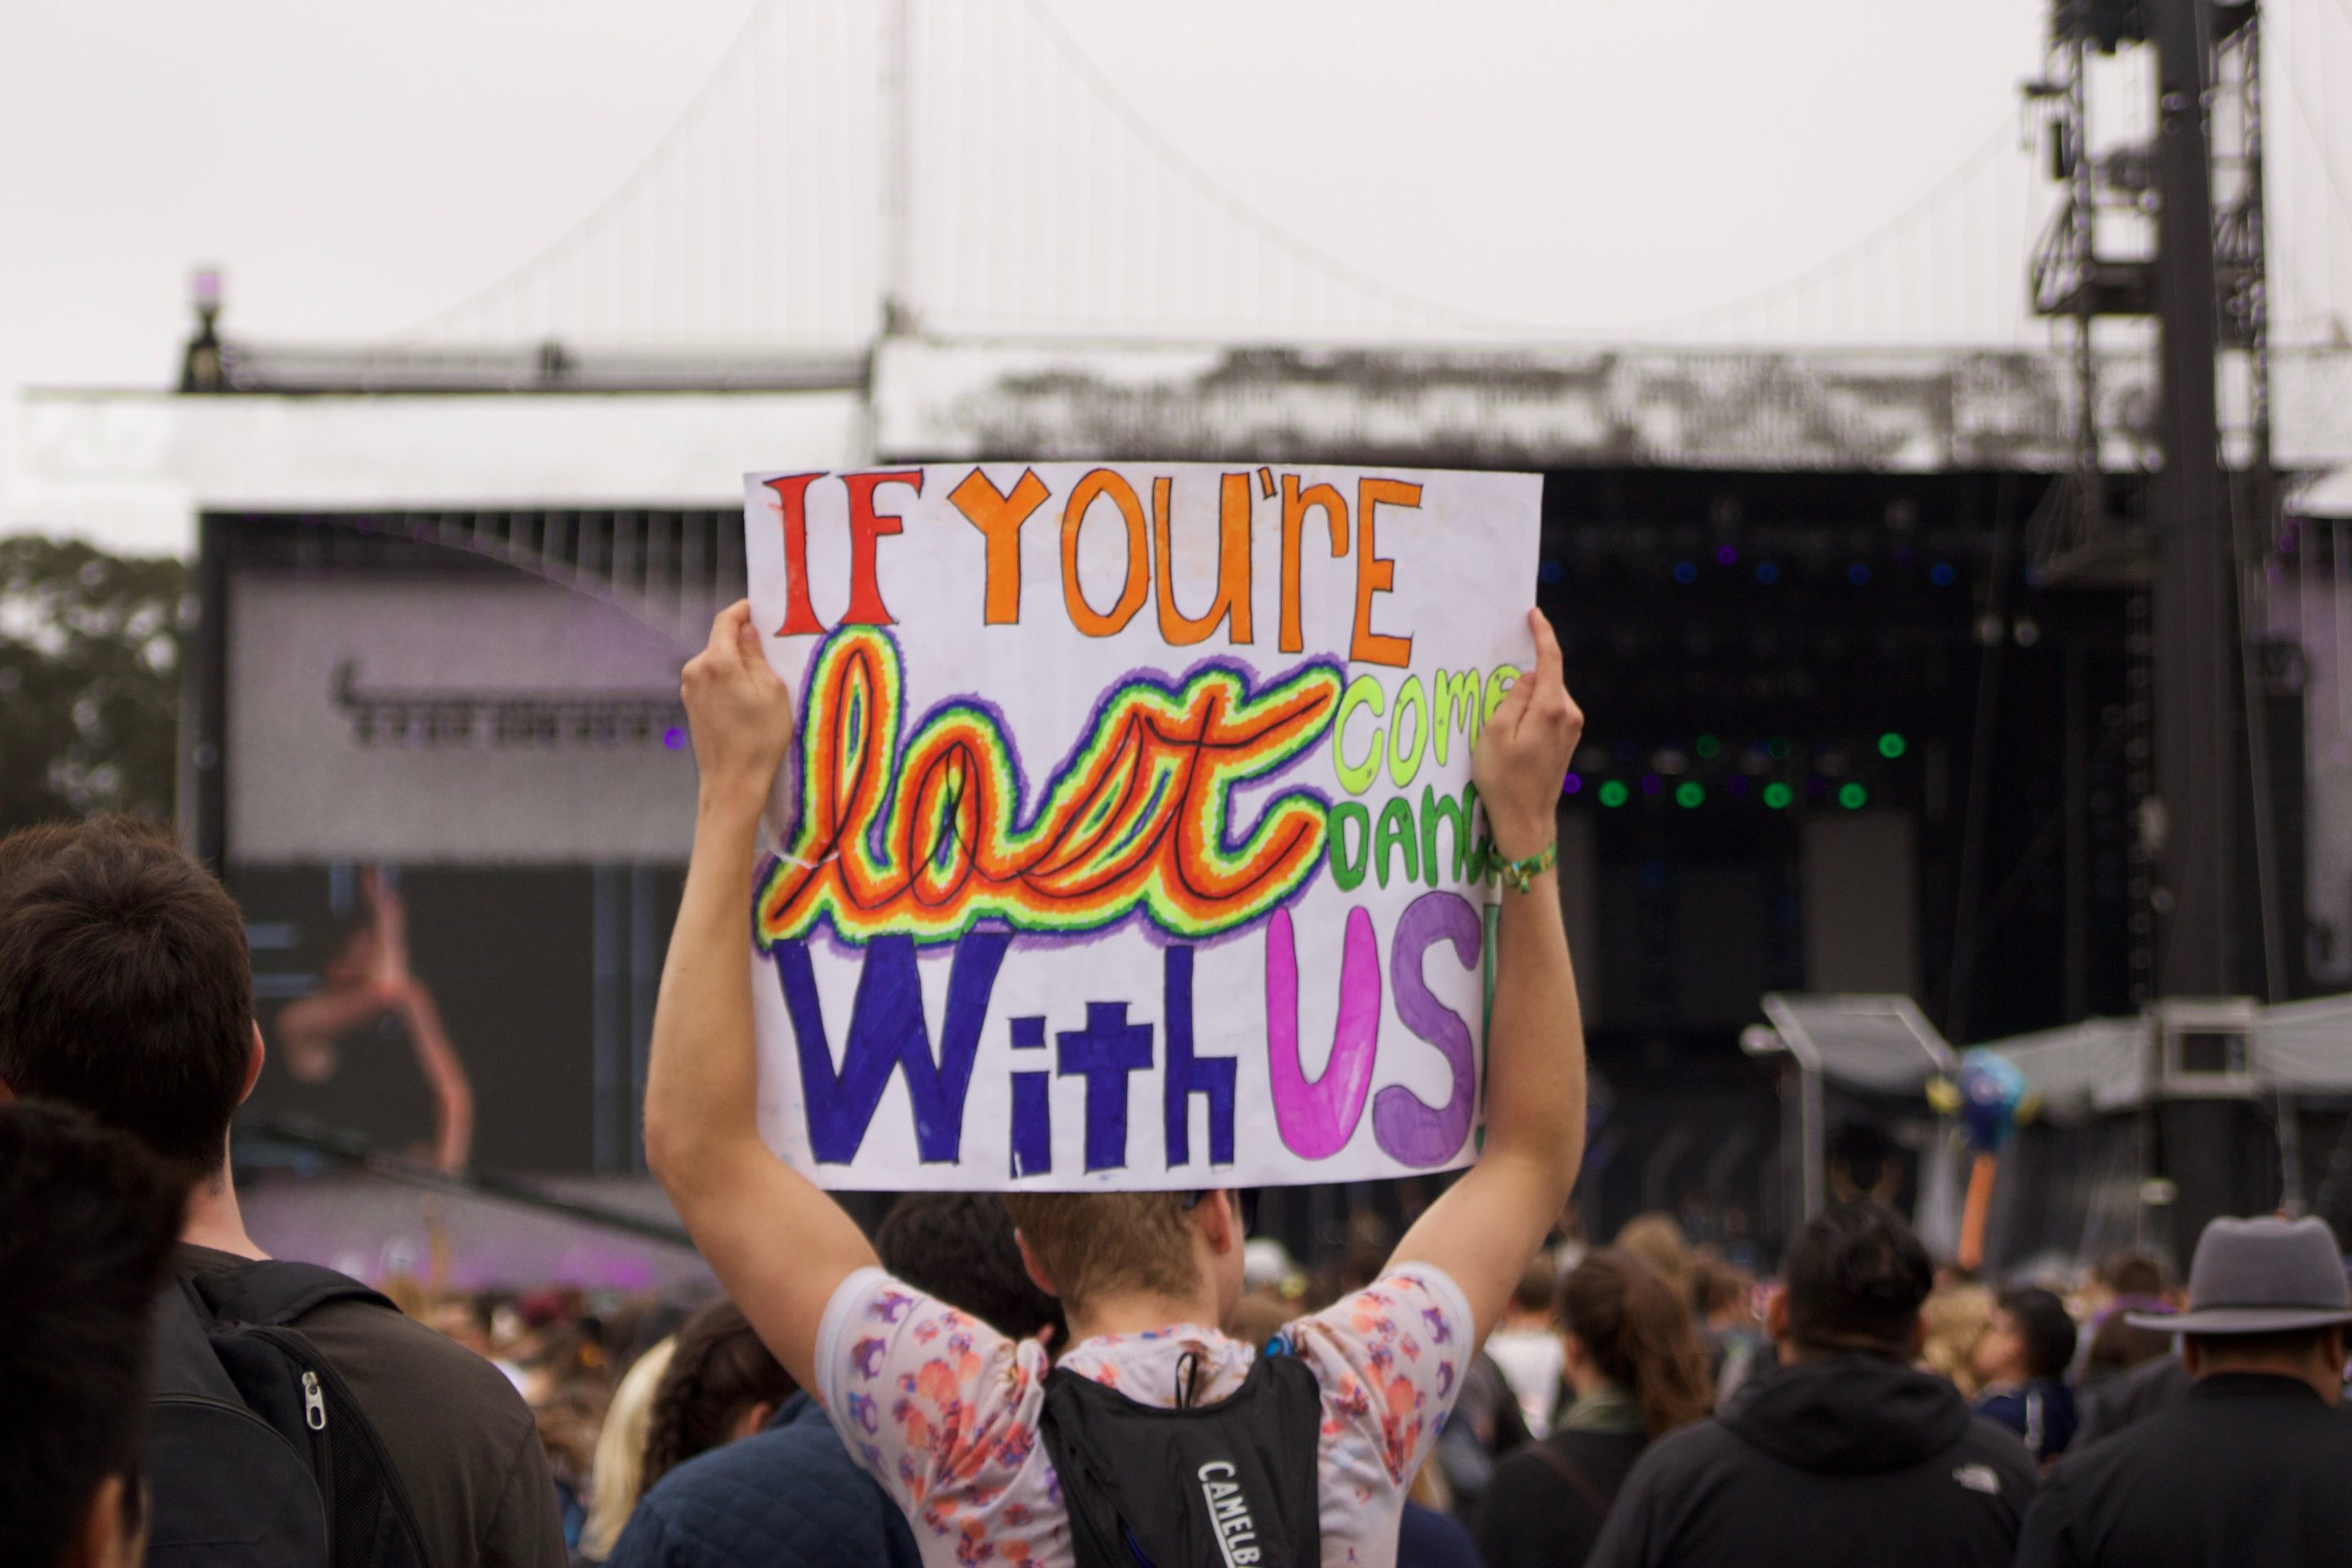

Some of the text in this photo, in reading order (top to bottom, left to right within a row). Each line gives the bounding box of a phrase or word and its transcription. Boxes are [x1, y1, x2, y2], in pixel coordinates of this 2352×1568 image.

[763, 470, 923, 636] IF
[751, 623, 1348, 952] lost
[1197, 1460, 1263, 1568] CAMELB
